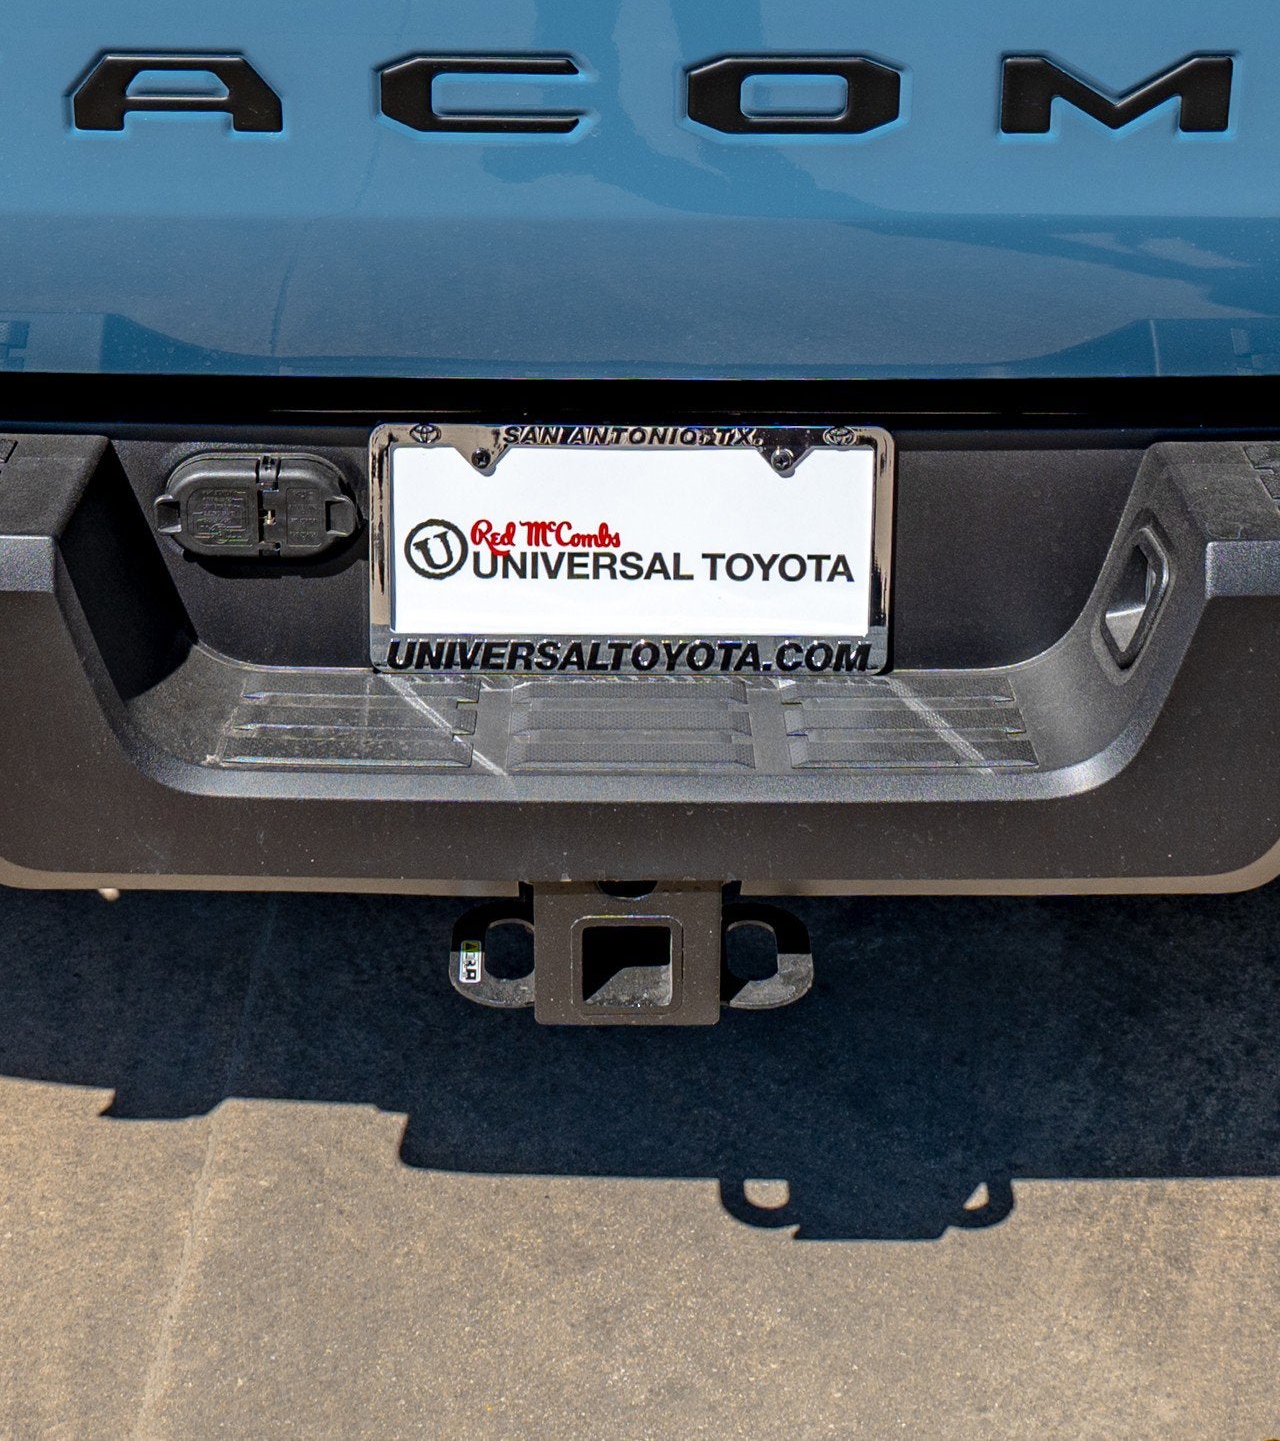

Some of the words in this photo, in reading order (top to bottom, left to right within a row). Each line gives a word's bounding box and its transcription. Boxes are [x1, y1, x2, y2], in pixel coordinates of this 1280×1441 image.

[503, 426, 564, 445] SAN
[470, 519, 516, 557] Red
[519, 520, 621, 549] McCombs
[472, 551, 695, 580] UNIVERSAL
[701, 552, 855, 583] TOYOTA
[387, 640, 873, 672] UNIVERSALTOYOTA.COM
